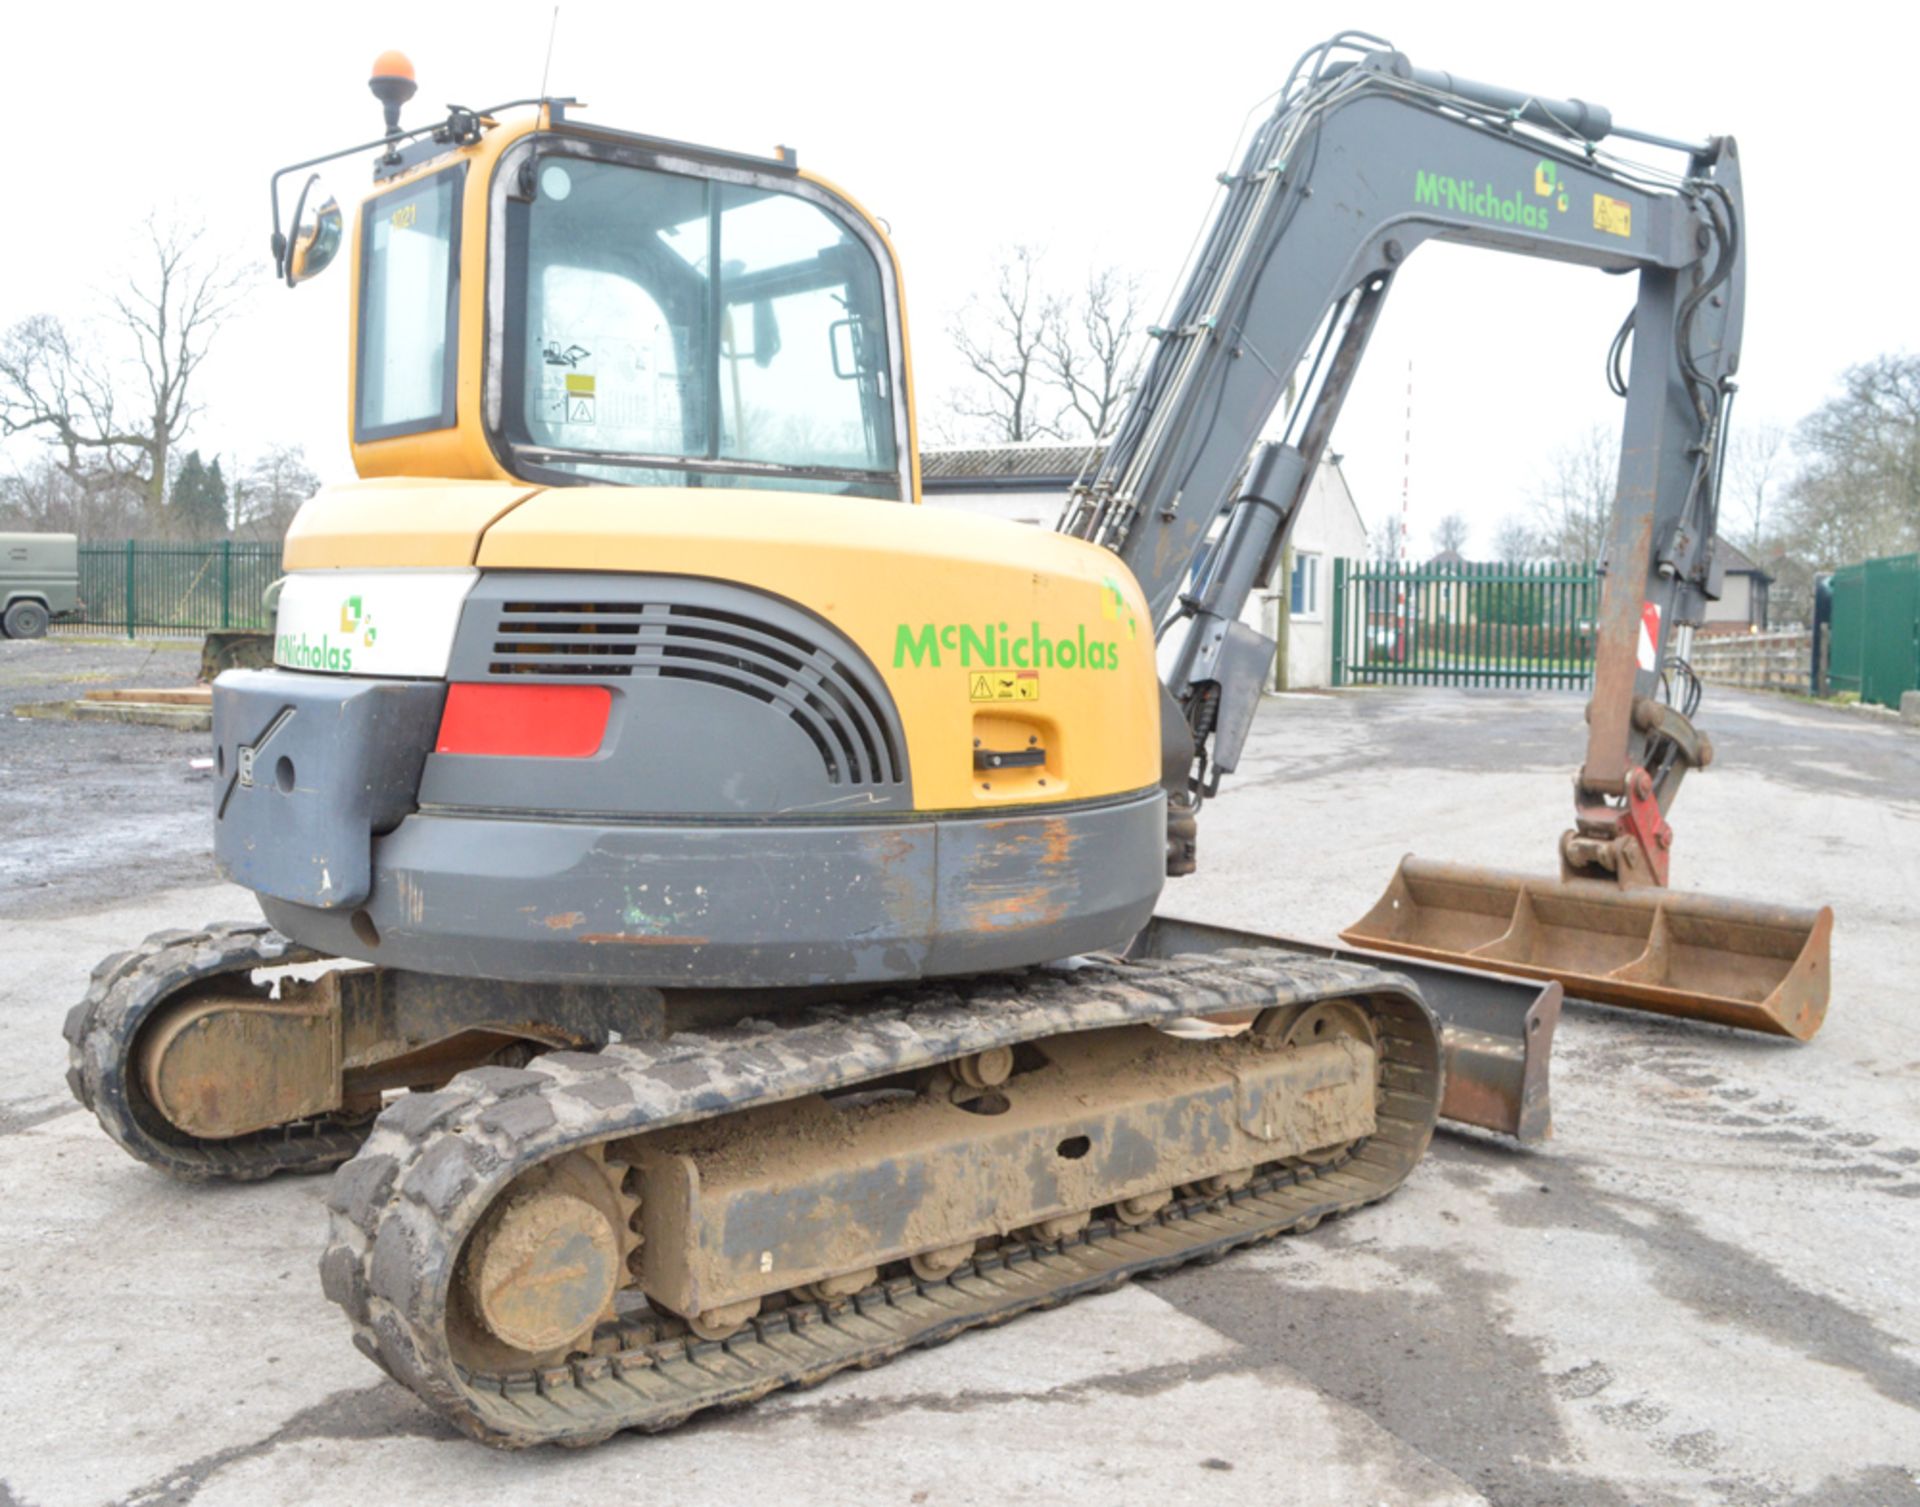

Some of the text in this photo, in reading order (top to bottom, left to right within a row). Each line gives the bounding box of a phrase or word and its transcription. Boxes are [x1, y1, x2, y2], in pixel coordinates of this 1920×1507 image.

[1414, 169, 1549, 231] McNicholas
[277, 632, 353, 672] Nicholas
[892, 621, 1119, 670] McNicholas
